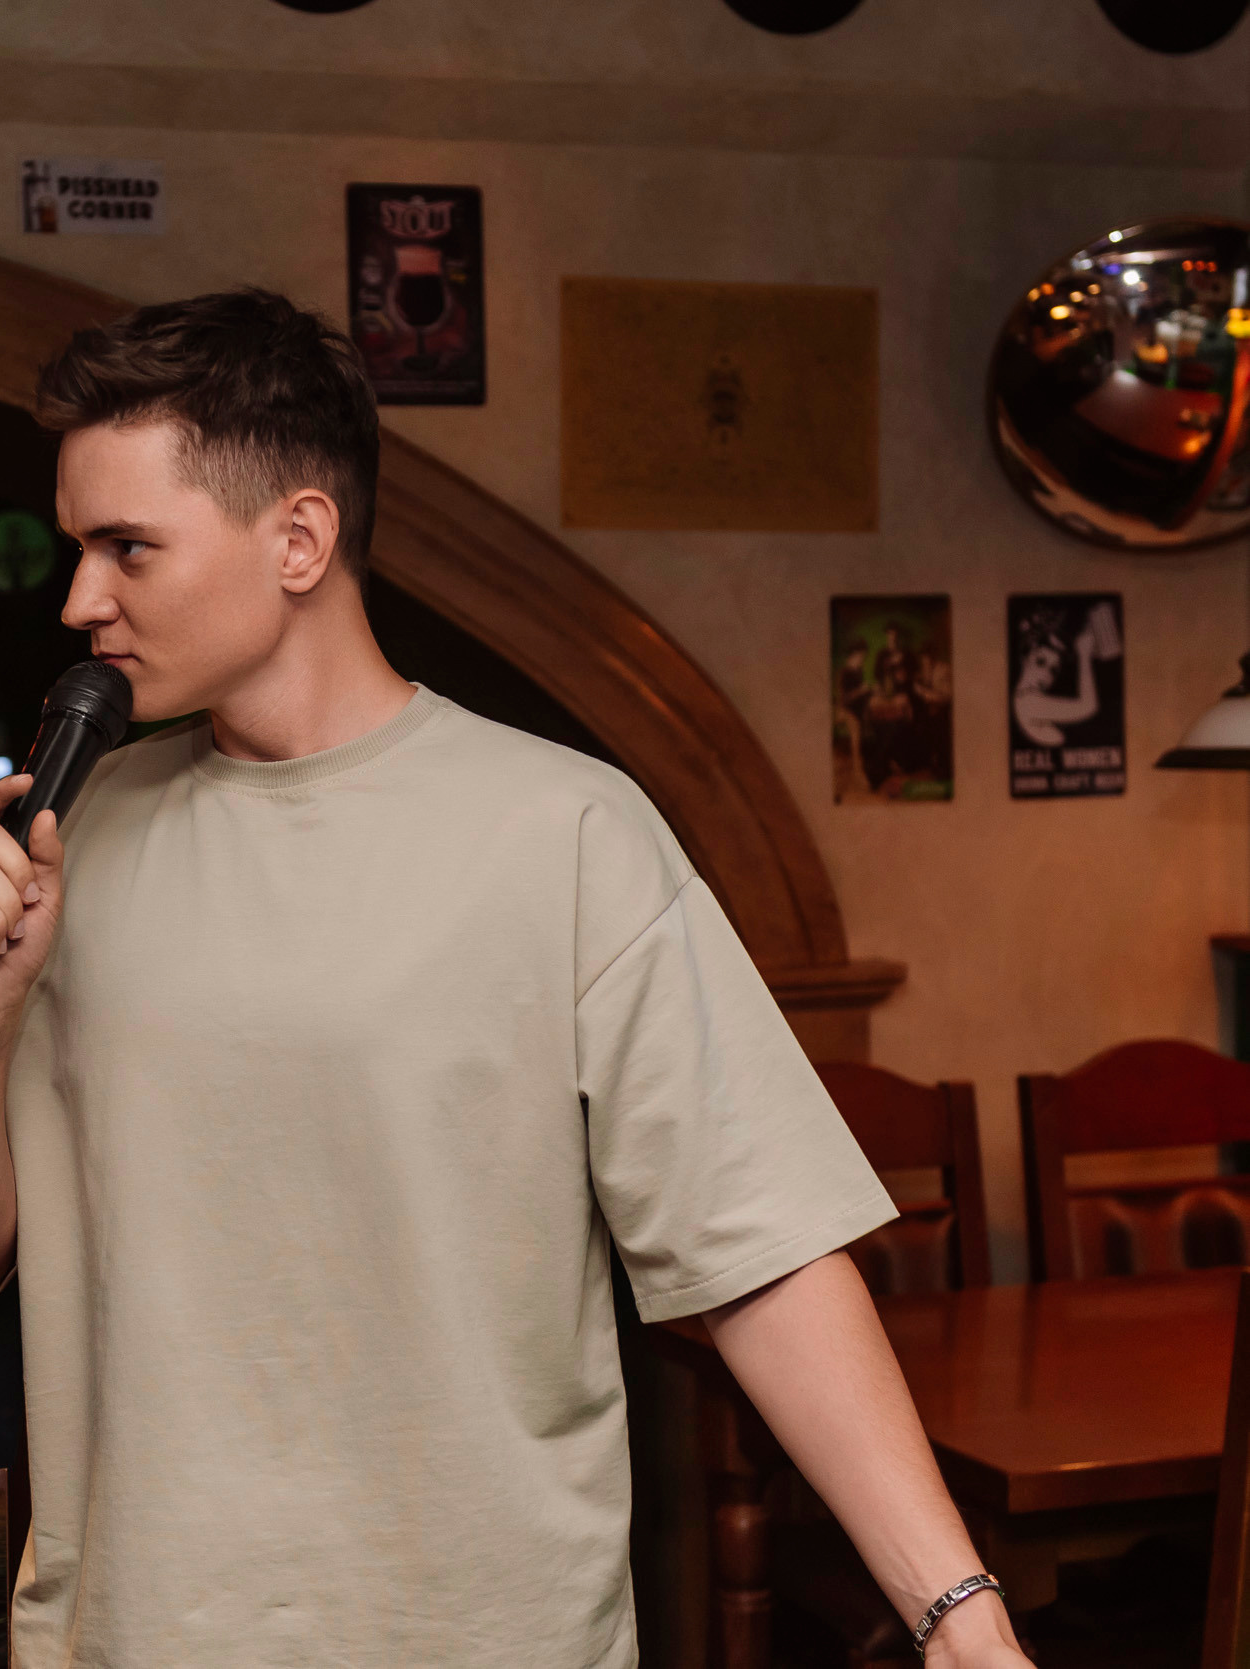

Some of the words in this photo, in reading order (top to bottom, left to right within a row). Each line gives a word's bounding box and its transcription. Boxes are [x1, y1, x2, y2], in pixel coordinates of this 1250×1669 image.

[58, 176, 159, 198] PISSHEAD
[67, 201, 153, 220] CORNER
[380, 197, 455, 240] STOUT
